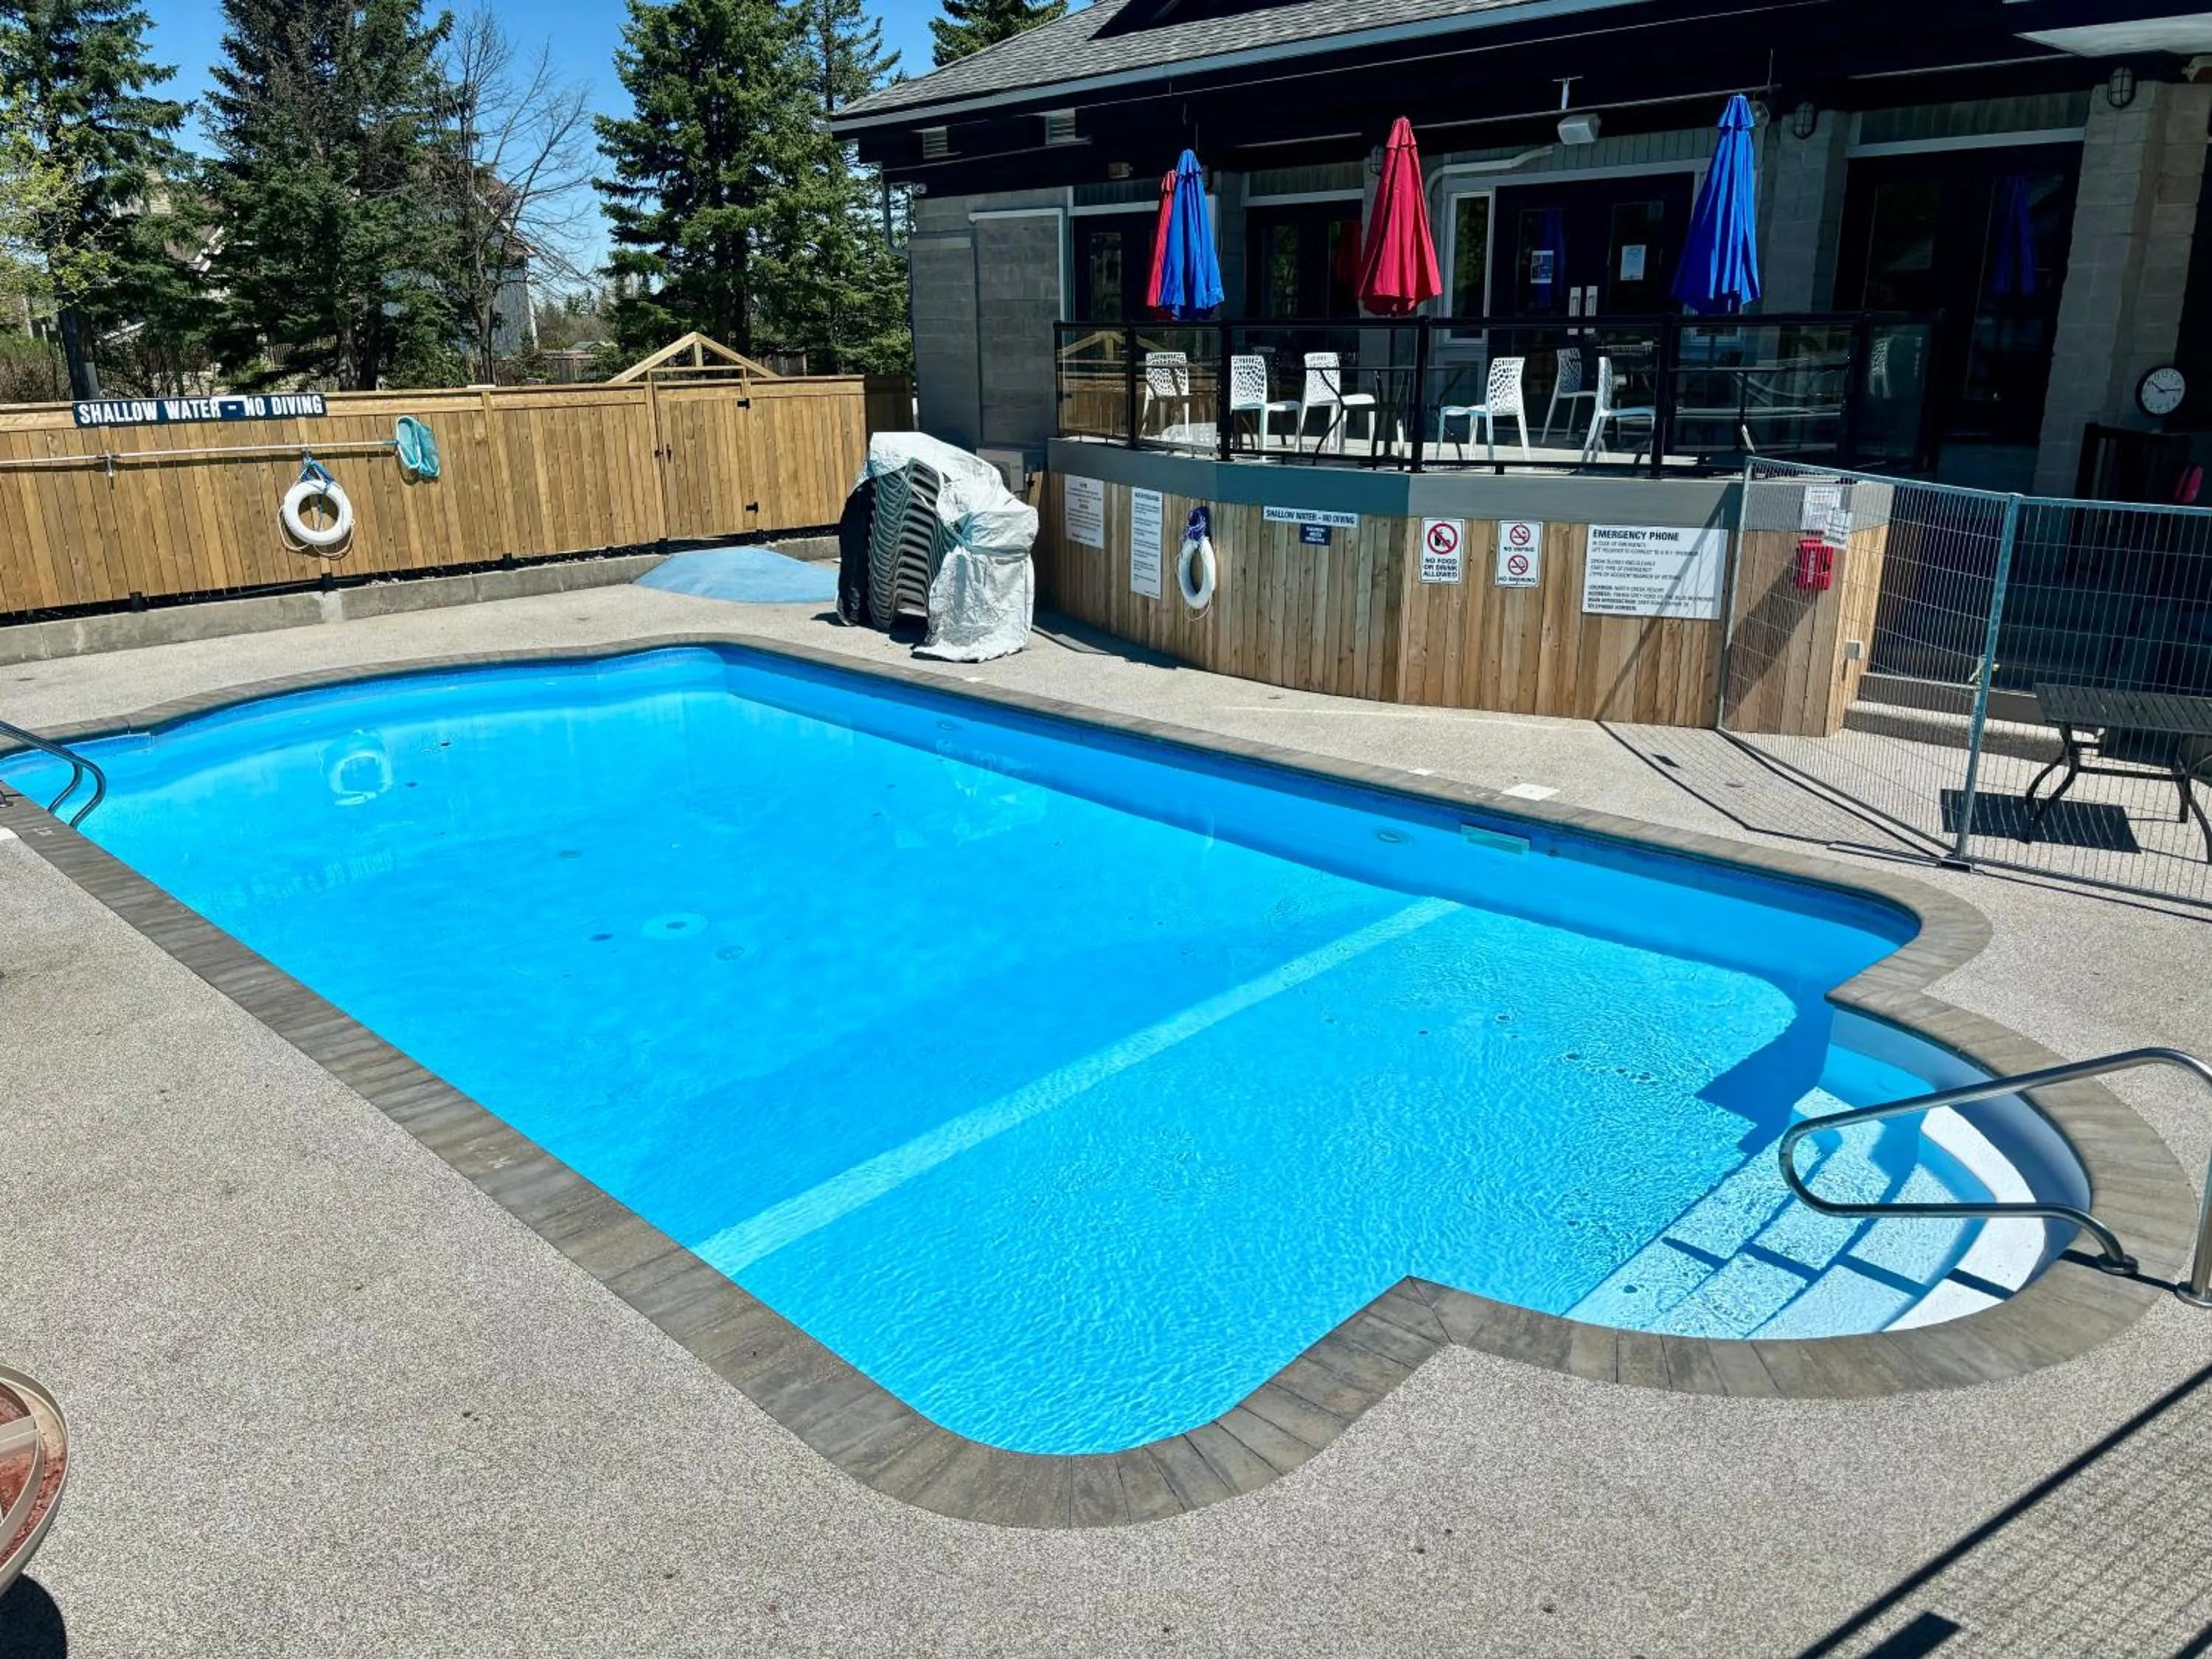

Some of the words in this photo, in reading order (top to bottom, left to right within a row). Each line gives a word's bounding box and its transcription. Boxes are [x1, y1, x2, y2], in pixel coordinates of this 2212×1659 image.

[79, 402, 158, 423] SHALLOW
[164, 399, 221, 420] WATER
[244, 397, 266, 417] NO
[272, 395, 323, 416] DIVING
[1266, 509, 1295, 518] SHALLOW
[1593, 529, 1647, 540] EMERGENCY
[1649, 532, 1680, 541] PHONE
